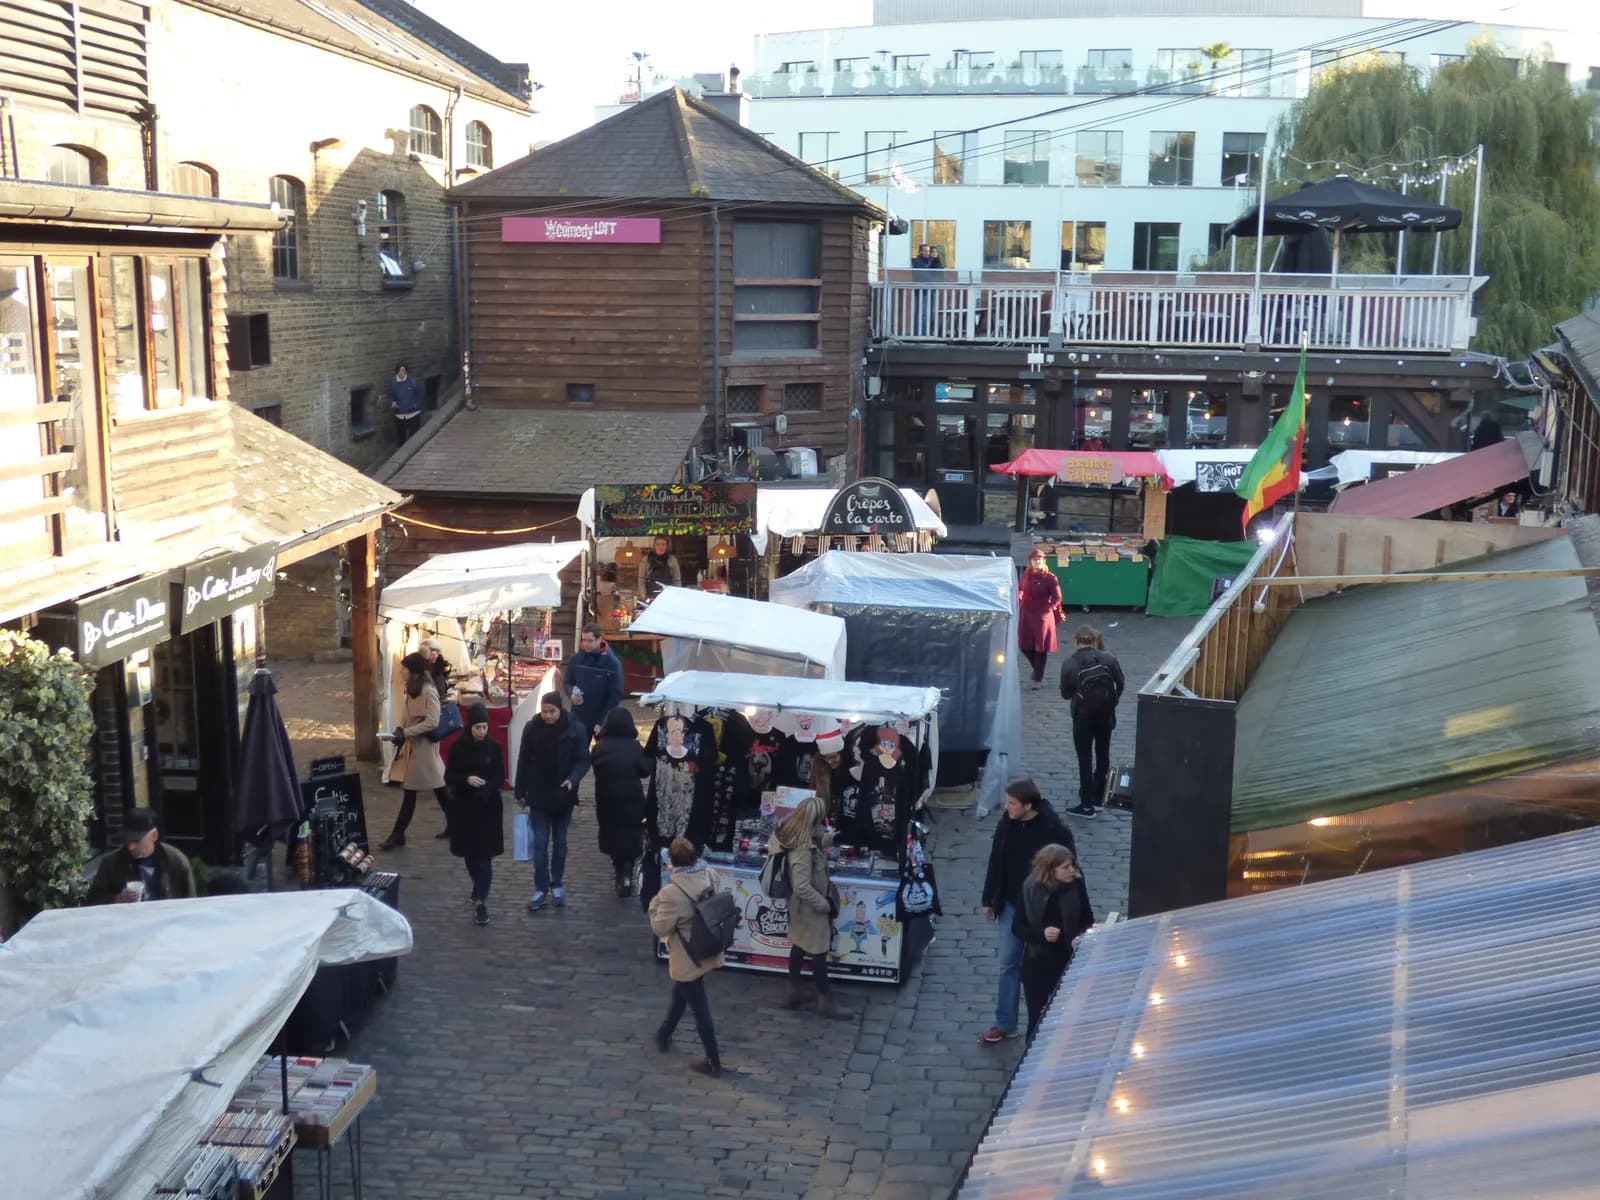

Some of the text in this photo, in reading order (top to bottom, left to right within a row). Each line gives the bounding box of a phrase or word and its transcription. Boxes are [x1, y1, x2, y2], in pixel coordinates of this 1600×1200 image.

[556, 221, 617, 240] Comedy LOFT
[1224, 466, 1243, 476] HOT
[700, 502, 738, 515] DRINKS
[833, 511, 904, 524] à la carte
